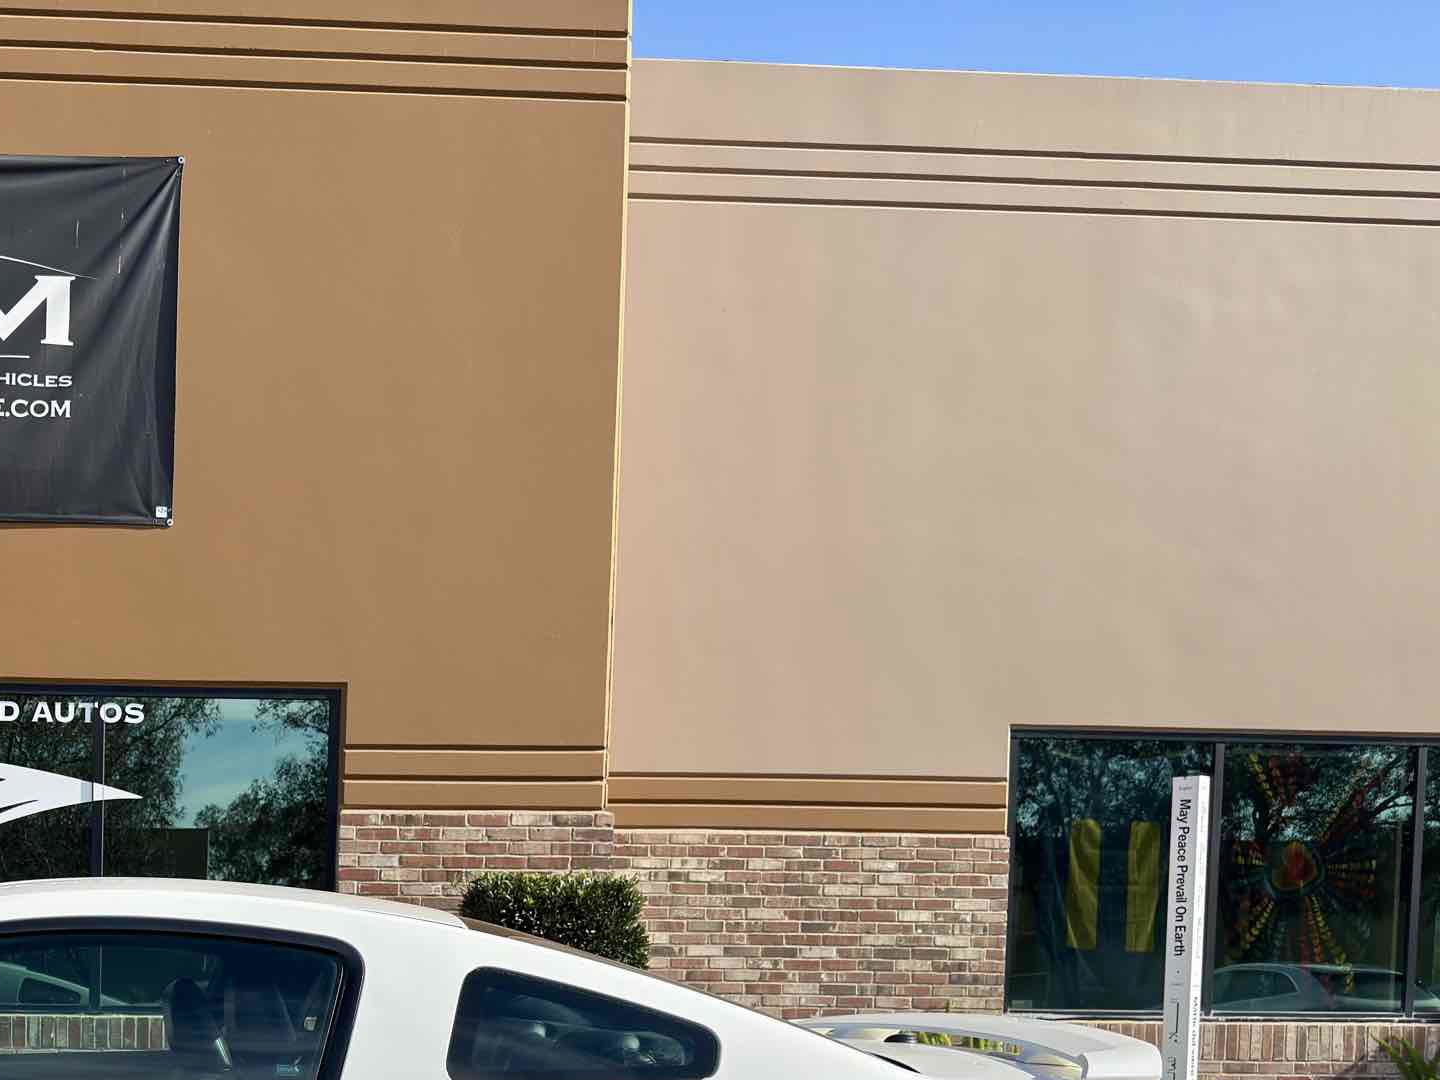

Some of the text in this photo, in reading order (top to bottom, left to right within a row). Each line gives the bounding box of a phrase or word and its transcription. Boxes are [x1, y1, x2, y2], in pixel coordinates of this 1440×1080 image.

[32, 701, 146, 724] AUTOS
[1176, 799, 1192, 823] May
[1176, 826, 1190, 863] Peace
[1175, 864, 1189, 904] Prevail
[1174, 906, 1187, 922] On
[1173, 925, 1187, 957] Earth
